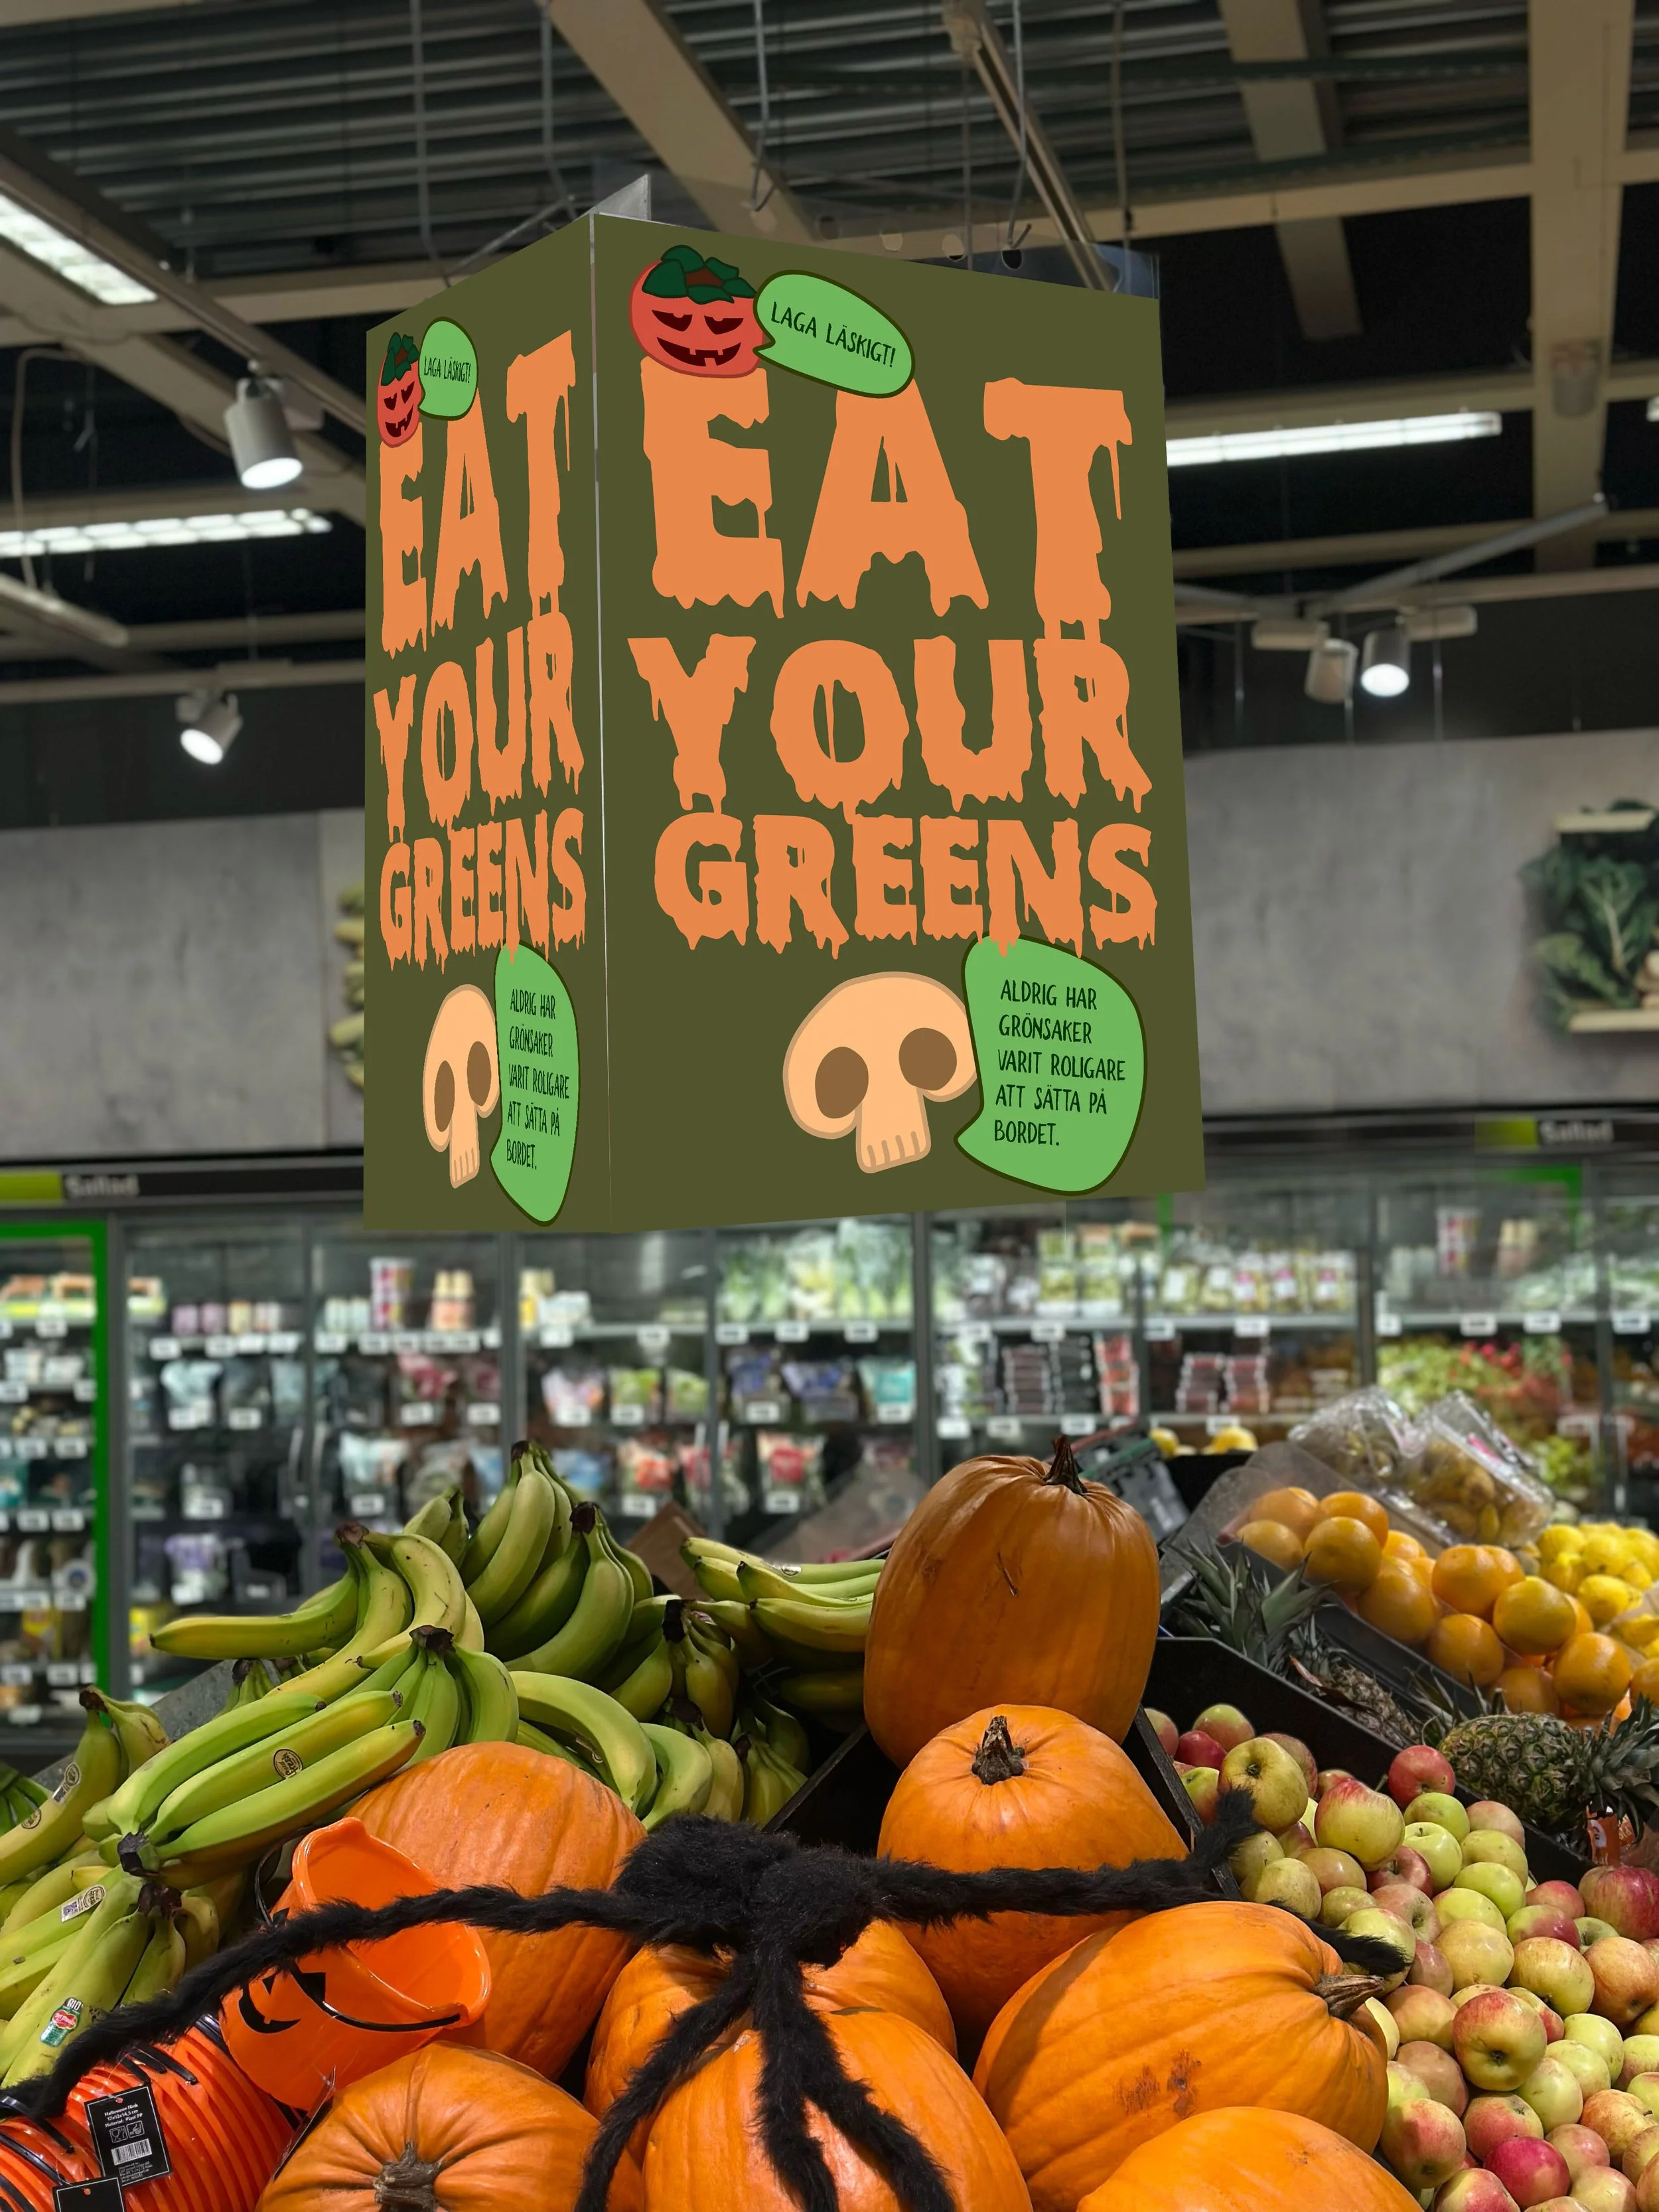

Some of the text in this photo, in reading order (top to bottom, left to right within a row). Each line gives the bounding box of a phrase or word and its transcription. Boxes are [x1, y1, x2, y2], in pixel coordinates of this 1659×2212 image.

[771, 301, 896, 368] LAGA LÄSKIGT!
[424, 356, 471, 384] LAGA LÄSKIGT!
[380, 330, 576, 658] EAT
[641, 356, 1132, 640] EAT
[374, 611, 585, 843] YOUR
[627, 634, 1152, 812] YOUR
[380, 808, 587, 974] GREENS
[654, 811, 1157, 958] GREENS
[510, 988, 555, 1019] ALDRIG HAR
[1000, 979, 1097, 1010] ALDRIG HAR
[509, 1024, 553, 1057] GRÖNSAKER
[999, 1012, 1092, 1044] GRÖNSAKER
[508, 1063, 569, 1099] VARIT ROLIGARE
[997, 1049, 1126, 1081] VARIT ROLIGARE
[995, 1084, 1107, 1115] ATT SÄTTA PÅ
[507, 1101, 560, 1136] ATT SÄTTA PÅ
[994, 1119, 1060, 1146] BORDET.
[506, 1138, 537, 1169] BORDET.
